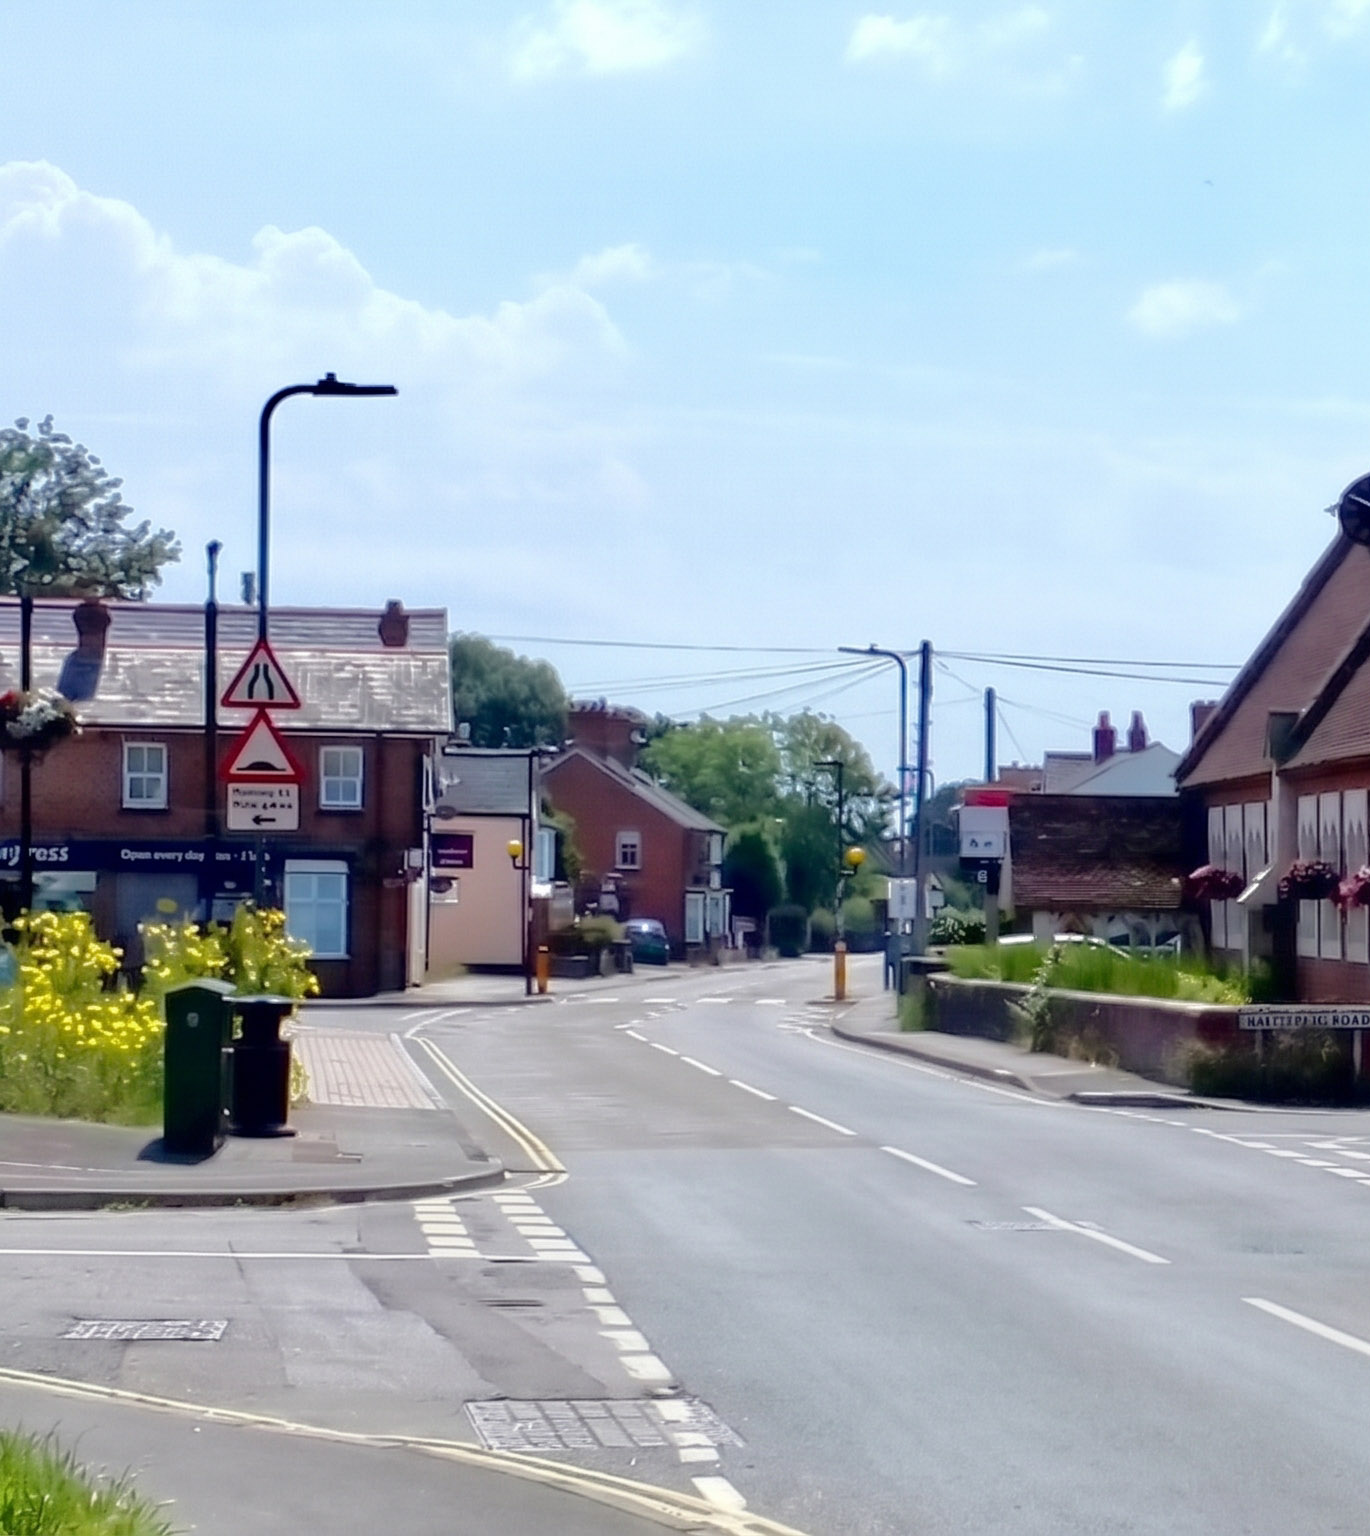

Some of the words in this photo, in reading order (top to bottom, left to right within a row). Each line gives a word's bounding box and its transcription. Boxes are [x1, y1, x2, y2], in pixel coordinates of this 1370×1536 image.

[121, 849, 152, 861] Open
[153, 851, 183, 862] every
[184, 850, 205, 862] day
[1332, 1014, 1370, 1026] ROAD
